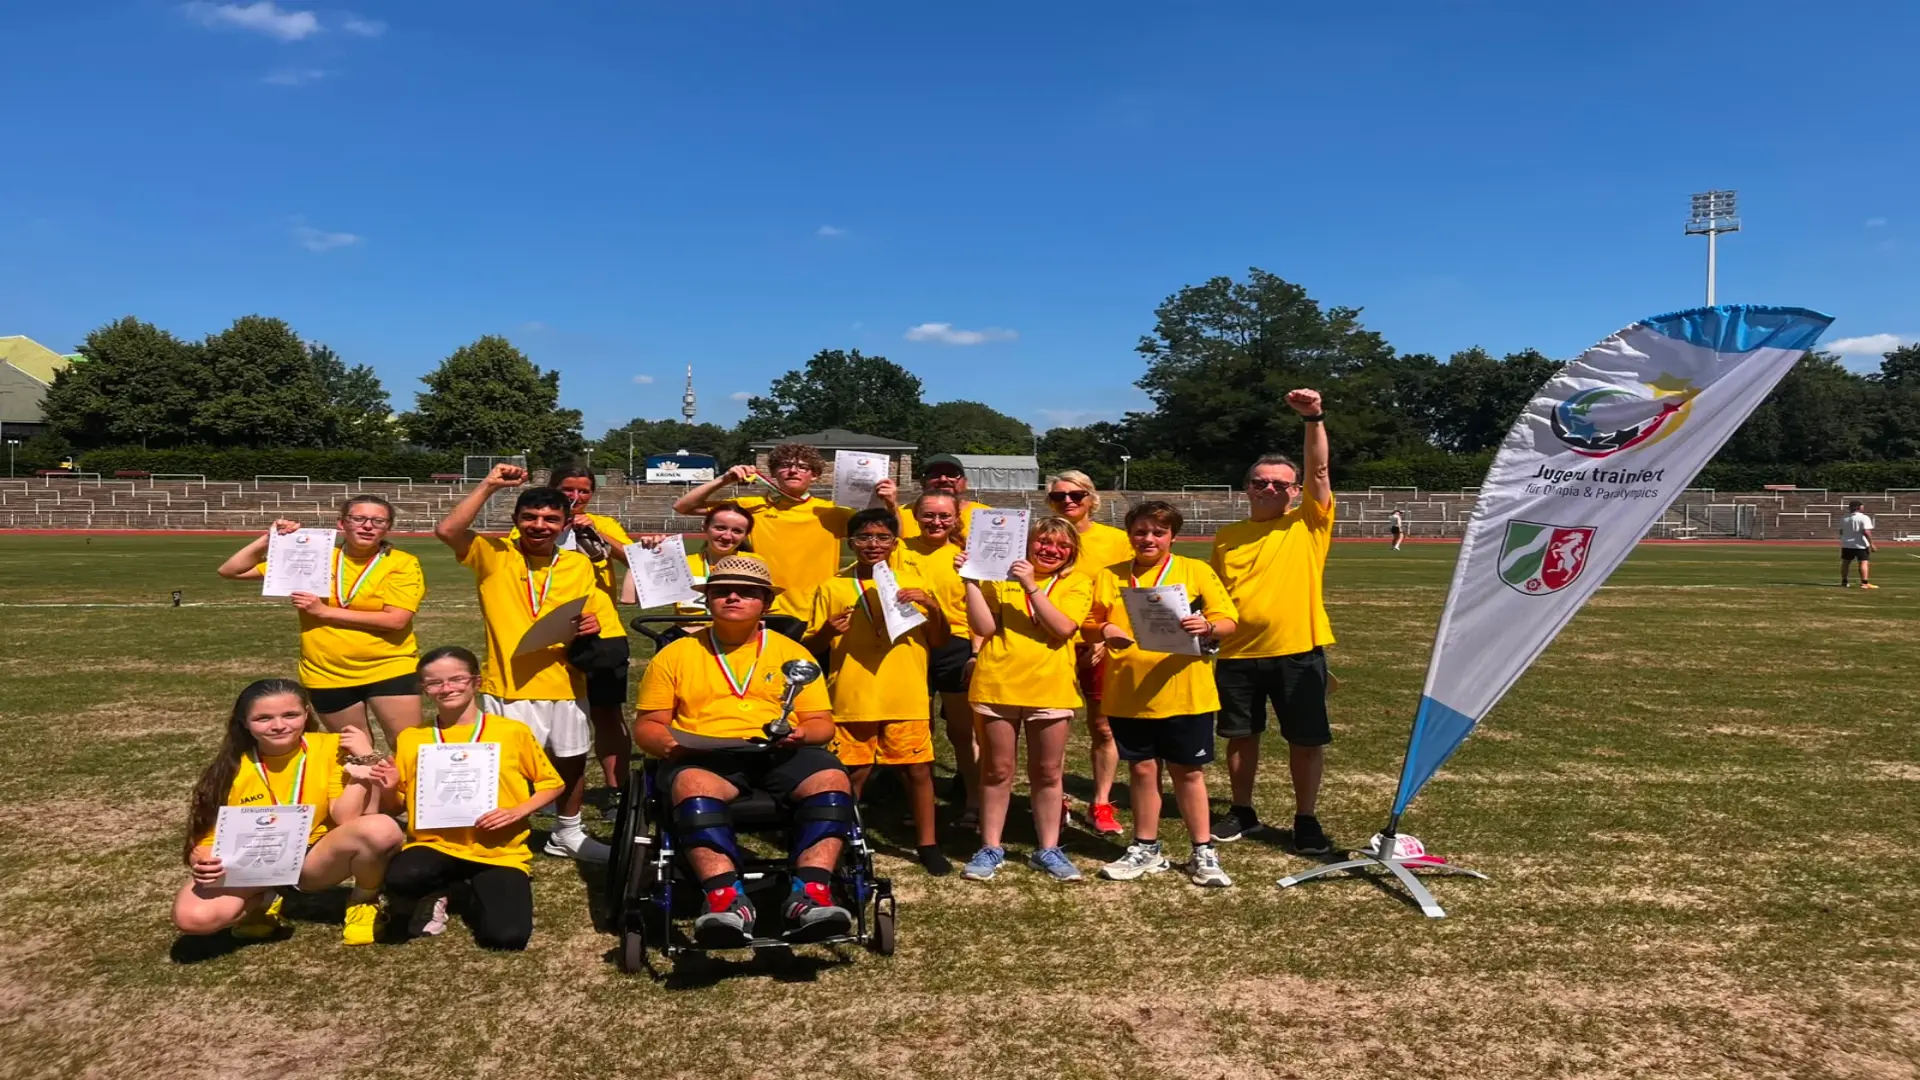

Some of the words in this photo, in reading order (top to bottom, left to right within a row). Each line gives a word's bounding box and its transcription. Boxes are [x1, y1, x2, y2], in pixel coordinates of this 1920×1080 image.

[1532, 464, 1589, 484] Jugend
[1592, 467, 1665, 484] trainiert
[1525, 483, 1541, 495] für
[1583, 486, 1593, 498] &
[1595, 487, 1659, 500] Paralympics
[240, 793, 264, 804] JAKO
